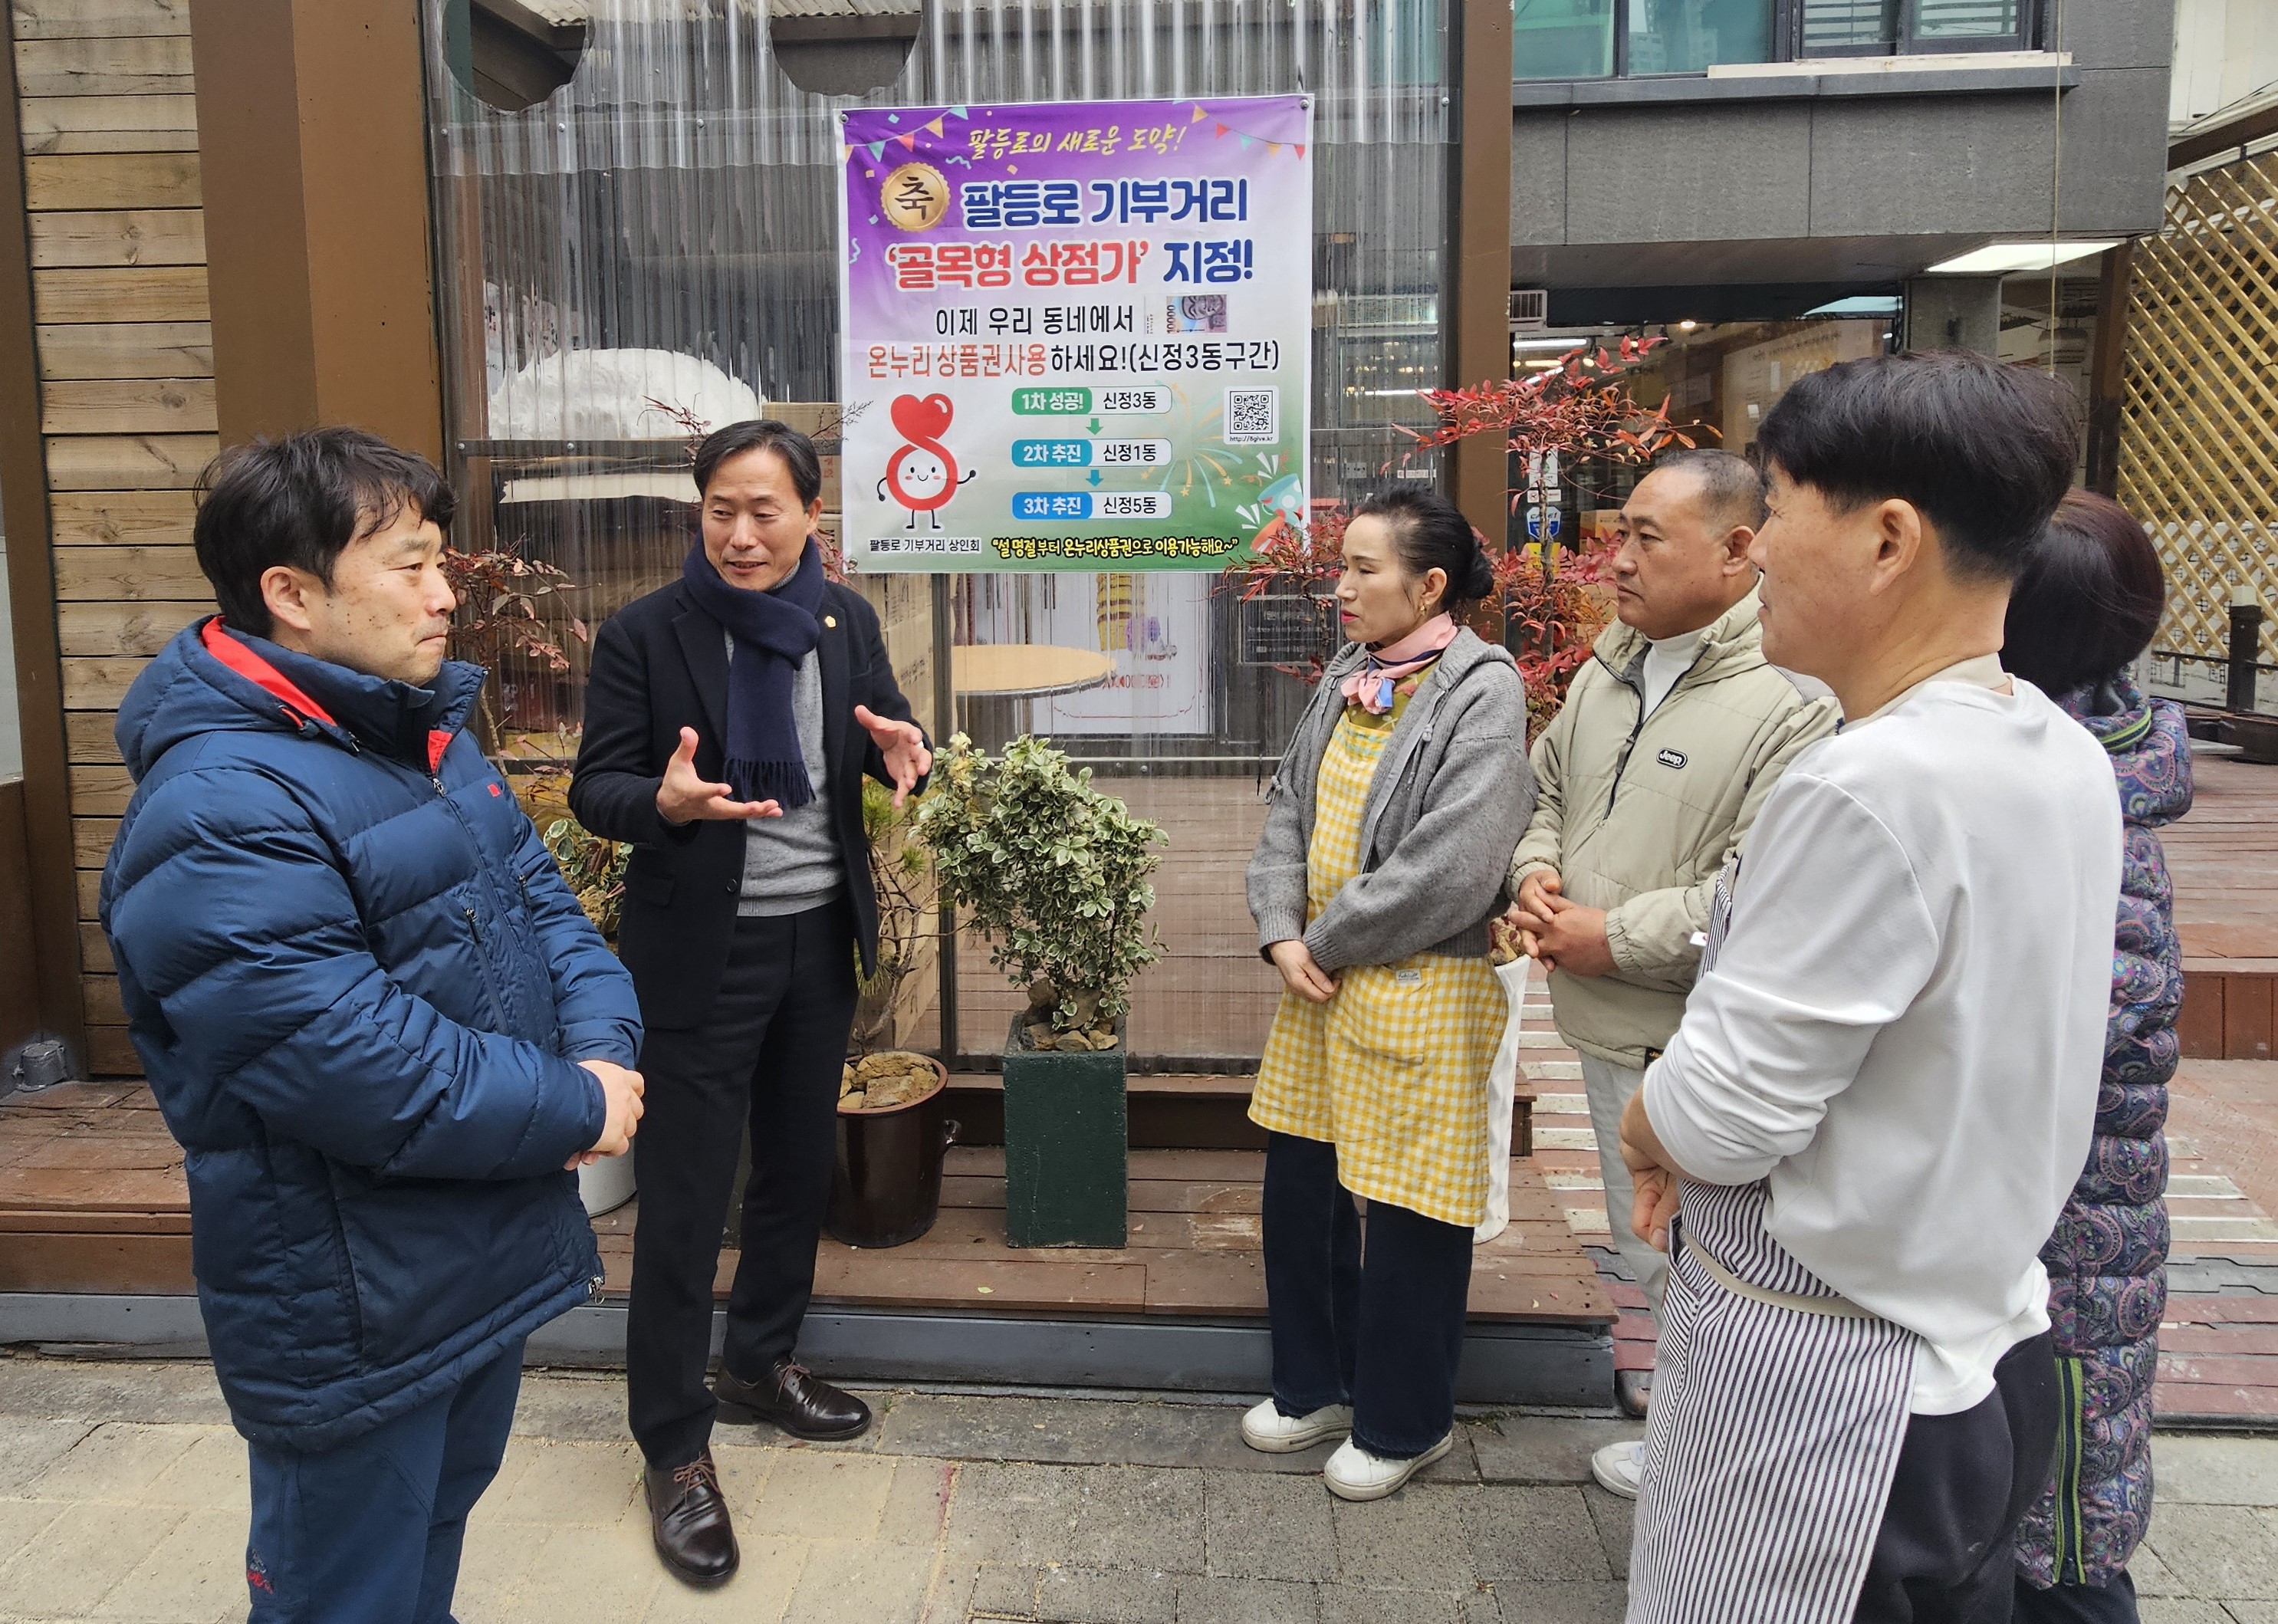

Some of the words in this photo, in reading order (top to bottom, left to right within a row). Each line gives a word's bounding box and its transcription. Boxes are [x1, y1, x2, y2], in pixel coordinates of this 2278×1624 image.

[968, 128, 1051, 159] 팔등로의
[1057, 126, 1122, 153] 새로운
[1127, 124, 1187, 153] 도약!
[893, 176, 935, 221] 축
[964, 183, 1080, 228] 팔등로
[1093, 179, 1248, 224] 기부거리
[1164, 239, 1254, 284] 지정!
[935, 308, 978, 336] 이제
[988, 307, 1033, 335] 우리
[1044, 305, 1133, 334] 동네에서
[1167, 304, 1176, 334] 10000
[1021, 393, 1046, 410] 1차
[1049, 391, 1084, 410] 성공!
[1103, 390, 1158, 409] 신정3동
[1024, 445, 1047, 462] 2차
[1051, 444, 1082, 463] 추진
[1103, 443, 1157, 462] 신정1동
[1024, 498, 1047, 515] 3차
[1051, 497, 1082, 515] 추진
[1103, 496, 1157, 514] 신정5동
[869, 539, 901, 552] 팔등로
[904, 539, 945, 552] 기부거리
[948, 539, 980, 552] 상인회
[1659, 750, 1683, 765] Jeep
